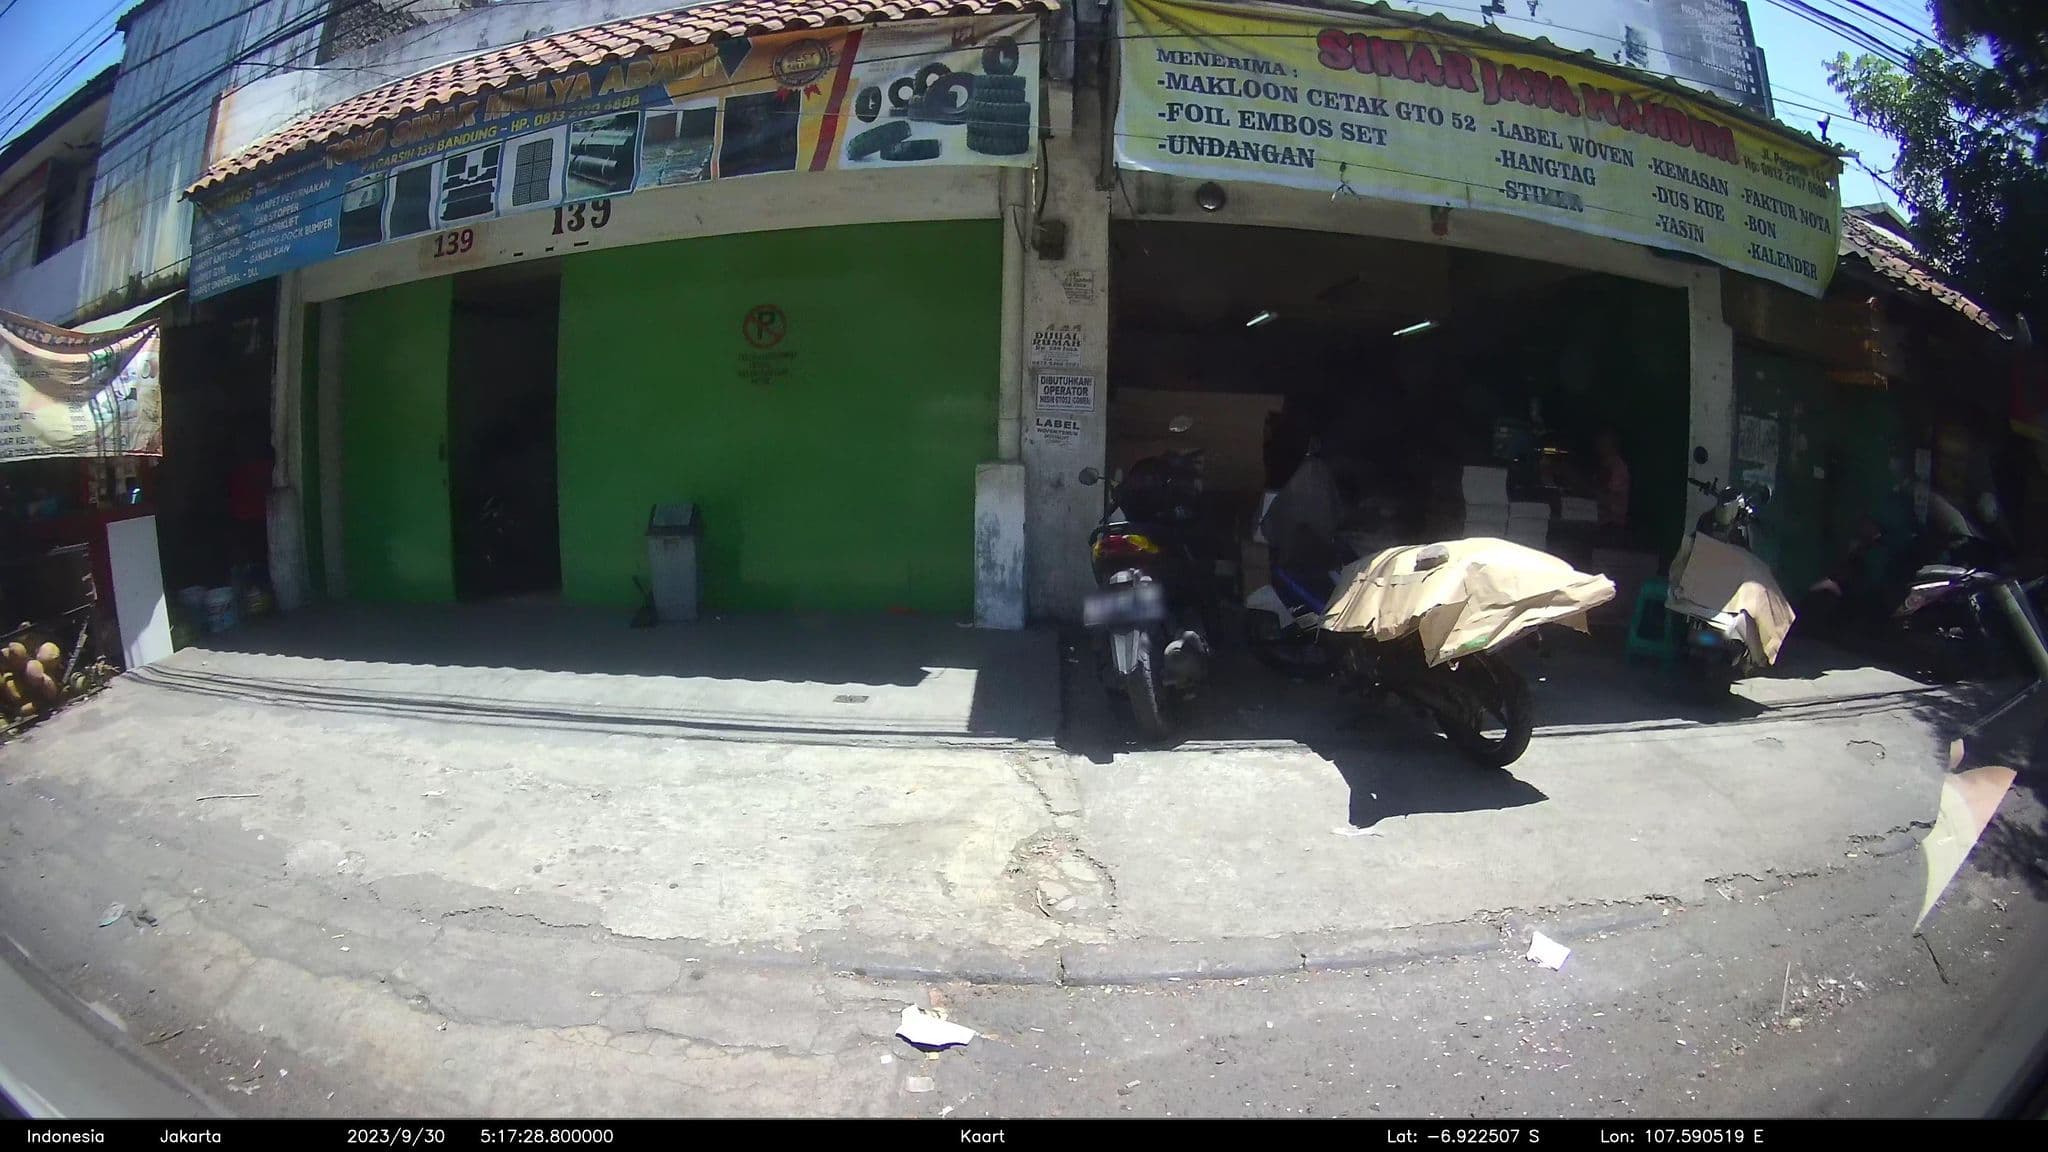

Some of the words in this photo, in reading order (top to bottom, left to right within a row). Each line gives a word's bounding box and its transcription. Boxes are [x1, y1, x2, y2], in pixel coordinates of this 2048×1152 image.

[1155, 48, 1286, 77] MENERIMA
[1317, 28, 1480, 93] SINAR
[325, 127, 388, 169] TOKO
[390, 99, 480, 147] SINAR
[484, 71, 592, 122] MULYA
[598, 43, 719, 96] ABADI
[1306, 88, 1389, 118] CETAK
[1395, 101, 1444, 126] GTO
[1451, 112, 1476, 132] 52
[437, 125, 498, 151] BANDUNG
[1238, 110, 1334, 138] EMBOS
[1340, 122, 1387, 146] SET
[1568, 134, 1634, 168] WOVEN
[552, 198, 611, 236] 139
[1694, 198, 1725, 222] KUE
[1799, 207, 1831, 236] NOTA
[303, 217, 333, 236] BUMPER
[433, 228, 474, 258] 139
[1043, 385, 1089, 396] OPERATOR
[1036, 417, 1080, 430] LABEL
